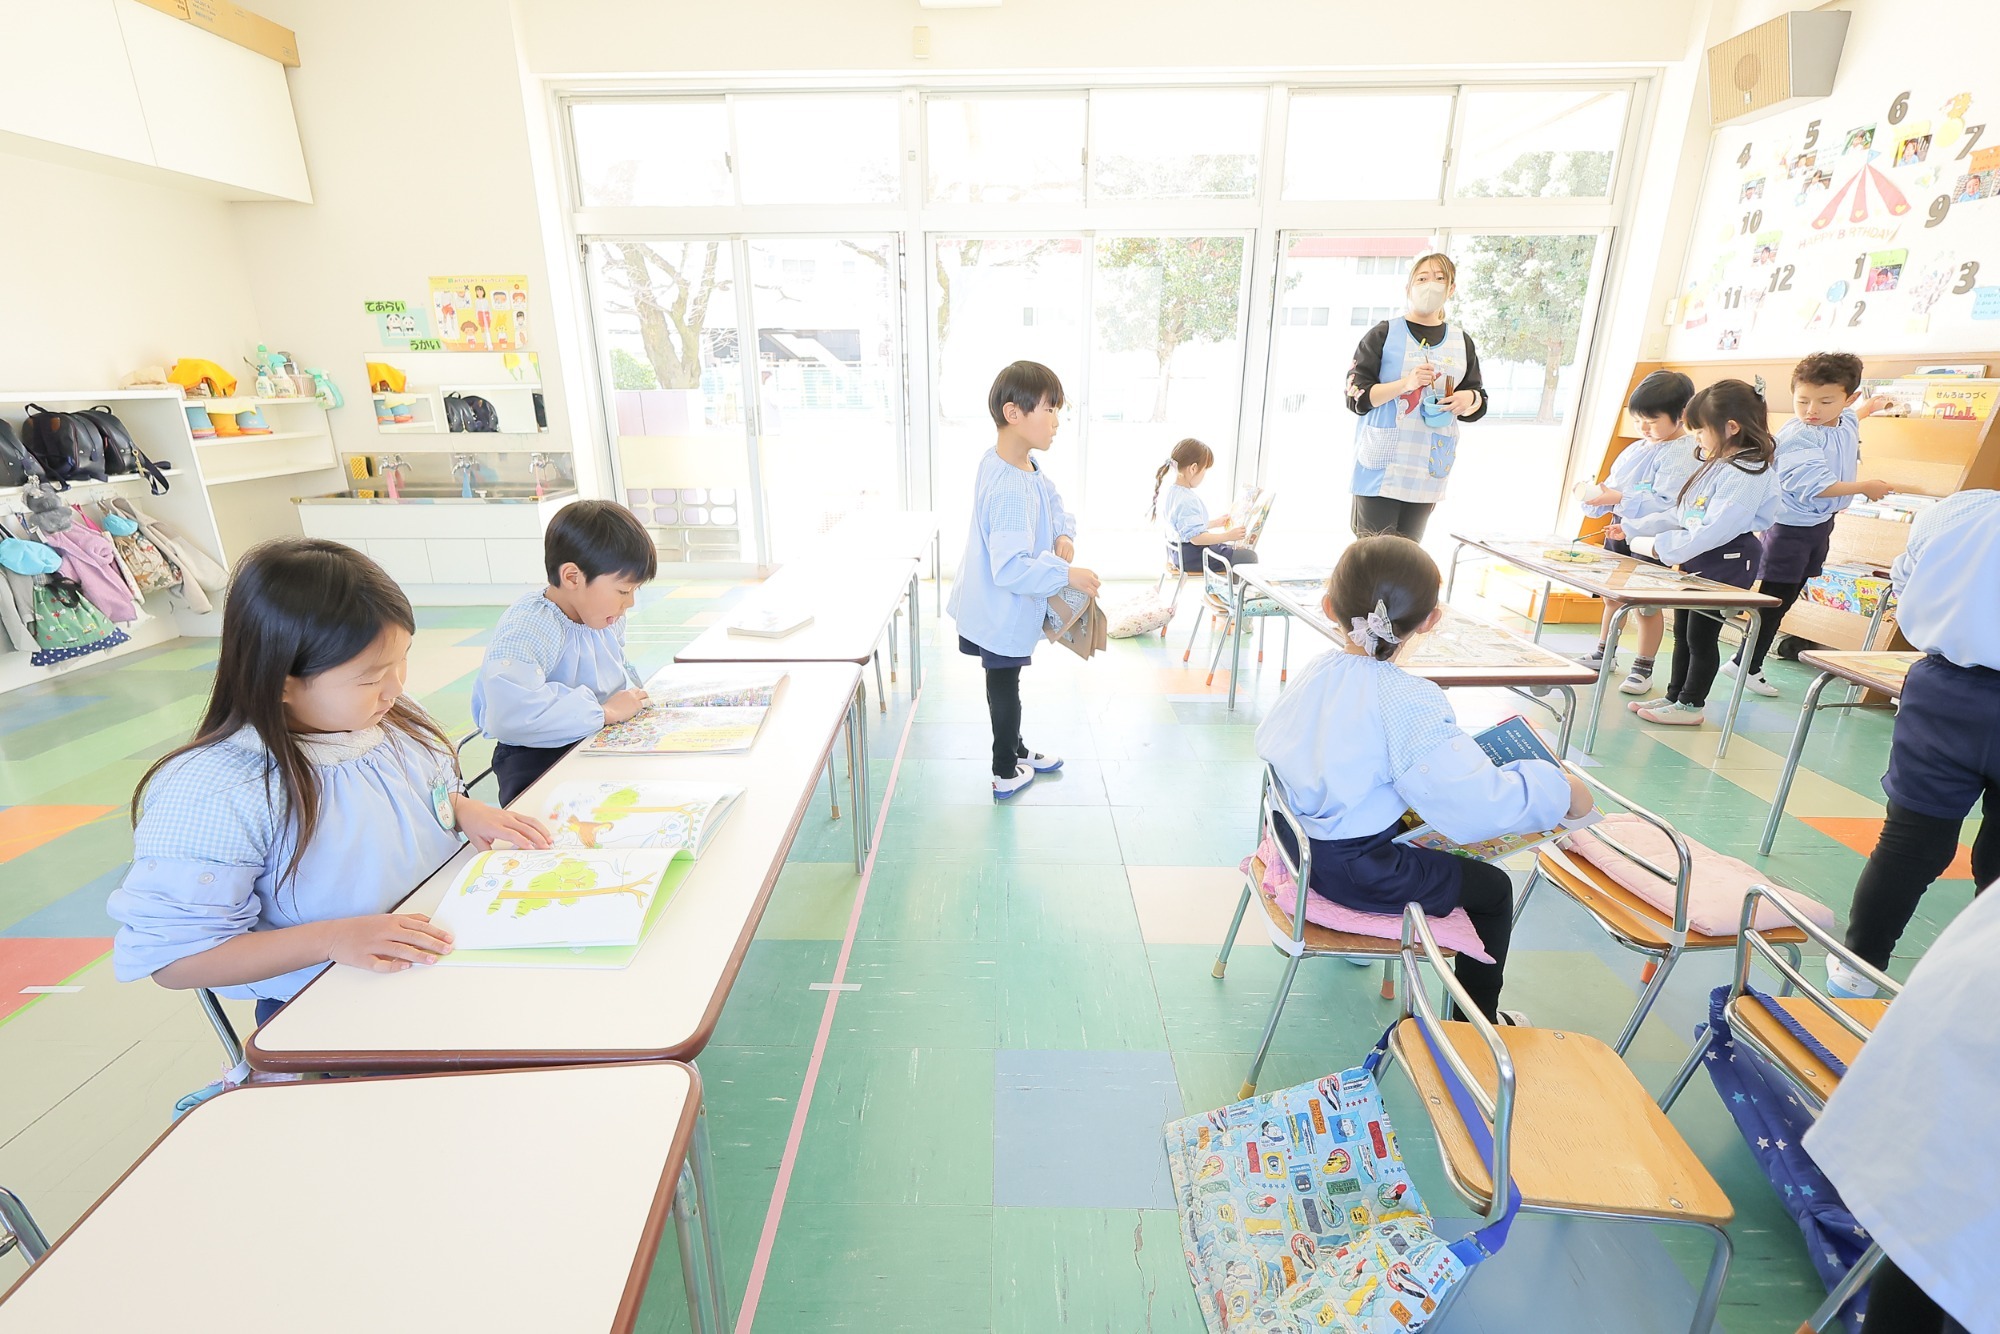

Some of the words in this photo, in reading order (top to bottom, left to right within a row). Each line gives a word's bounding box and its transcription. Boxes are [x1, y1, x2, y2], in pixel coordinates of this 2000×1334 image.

[1888, 91, 1911, 125] 6
[1803, 119, 1822, 150] 5
[1955, 123, 1986, 161] 7
[1736, 142, 1753, 169] 4
[1740, 209, 1763, 235] 10
[1924, 194, 1951, 228] 9
[1798, 231, 1834, 249] HAPPY
[1837, 226, 1893, 240] BRTHDAY
[1768, 264, 1796, 293] 12
[1853, 252, 1867, 280] 1
[1952, 260, 1980, 295] 3
[365, 301, 405, 312] てあらい
[1724, 285, 1743, 310] 11
[1848, 300, 1867, 327] 2
[410, 340, 441, 350] うかい
[1936, 391, 1987, 400] せんろはつづく
